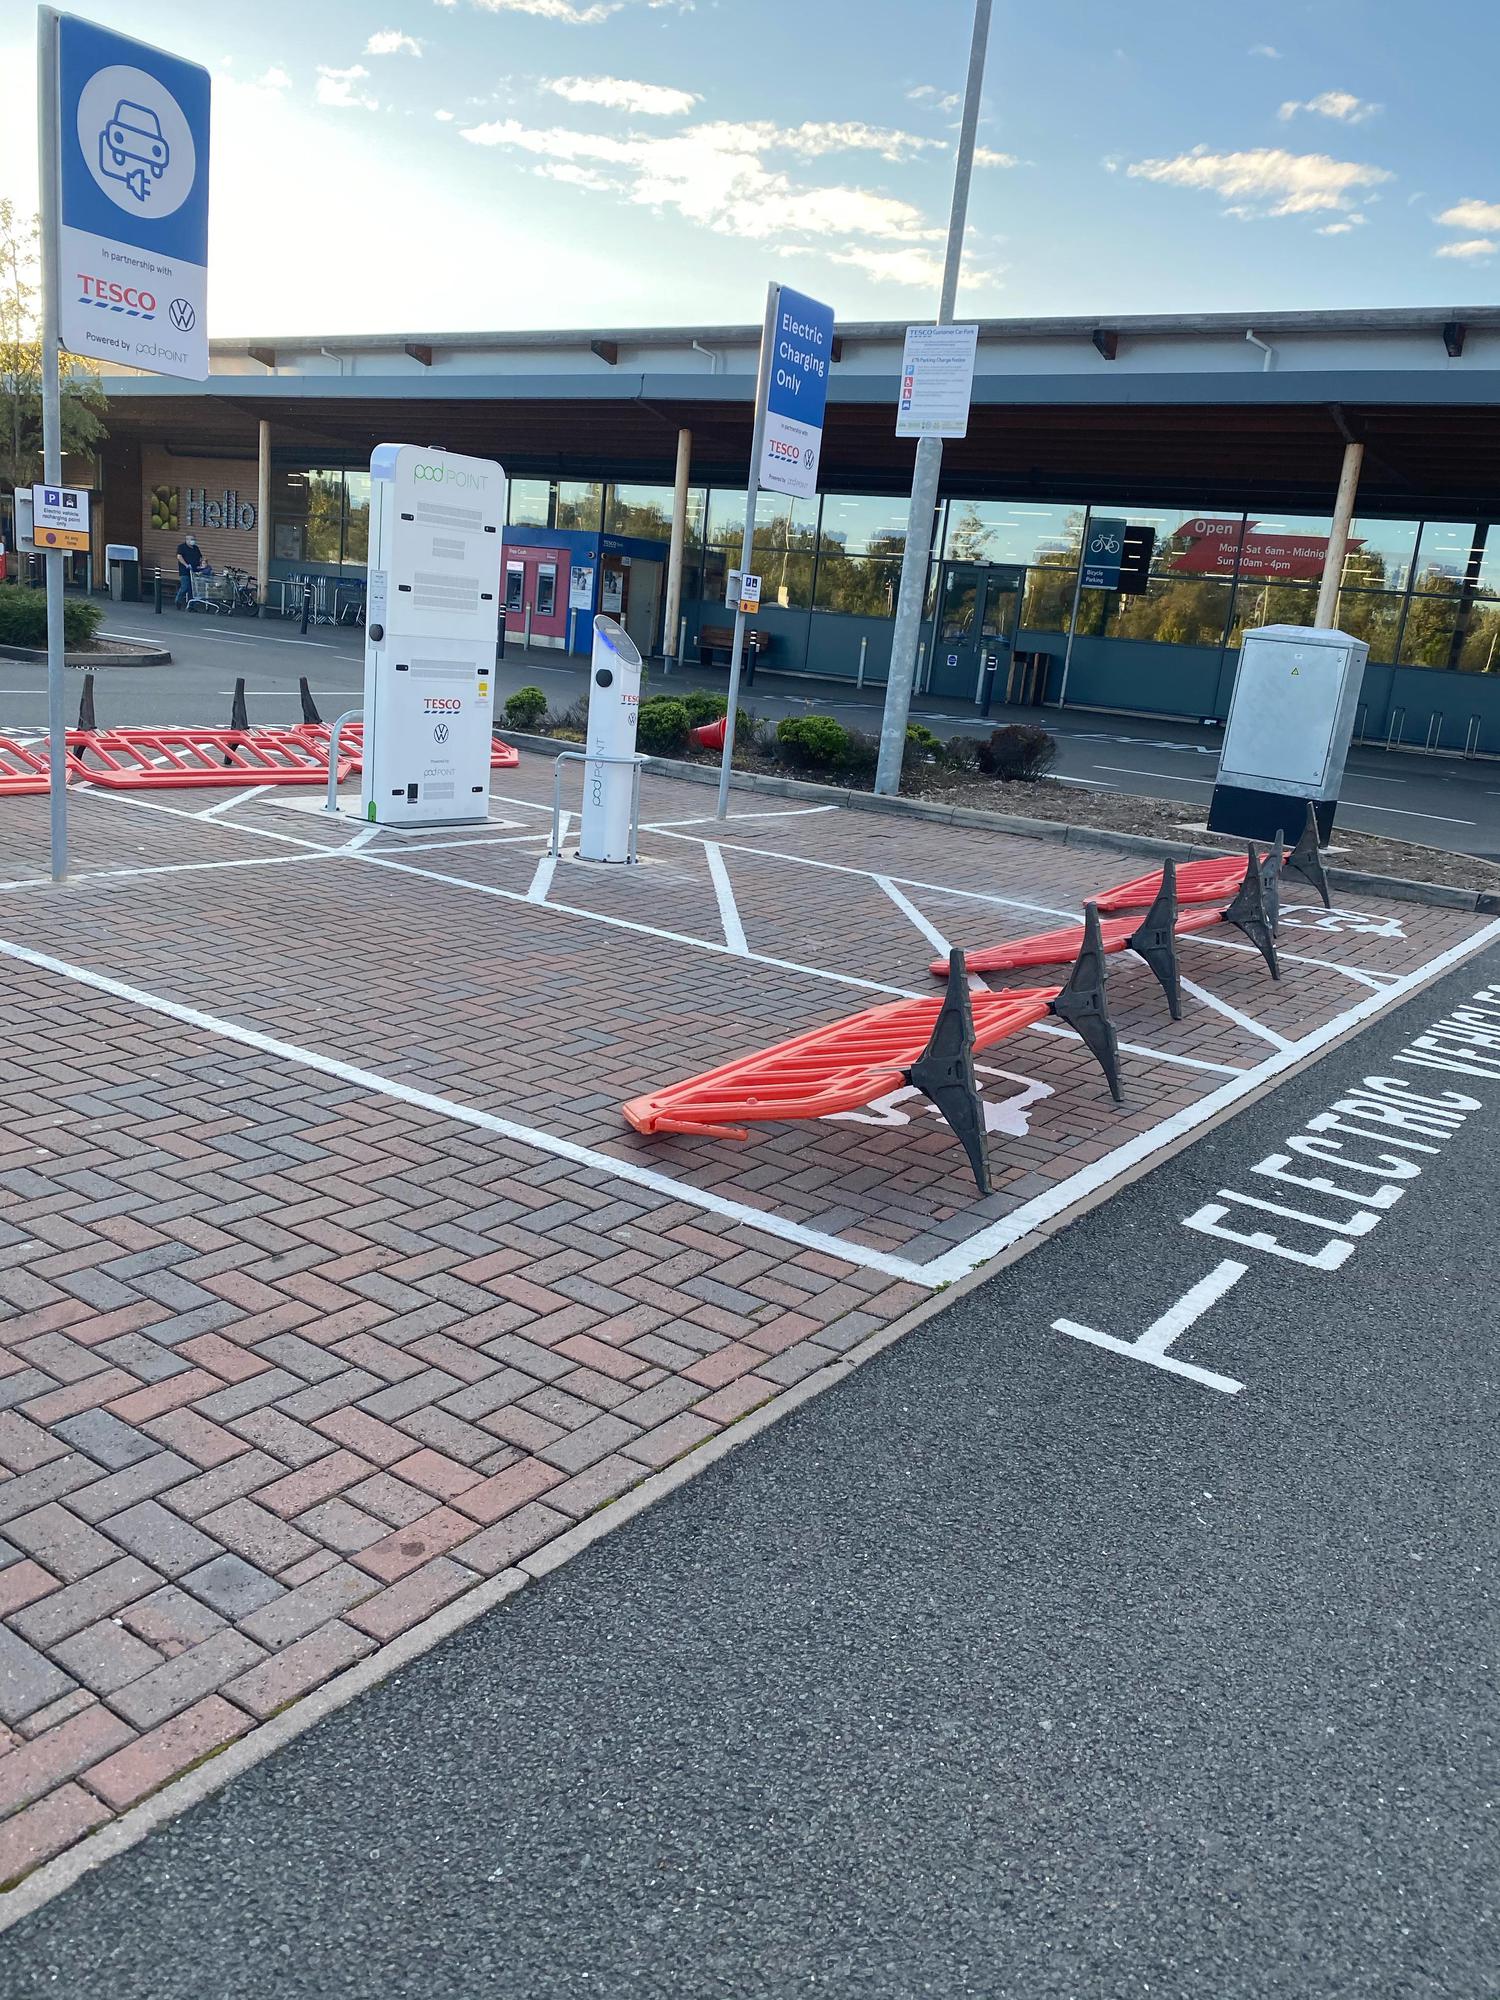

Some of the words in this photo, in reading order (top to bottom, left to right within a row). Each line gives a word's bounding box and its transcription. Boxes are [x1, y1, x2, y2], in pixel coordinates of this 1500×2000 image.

[102, 249, 109, 258] In
[111, 252, 155, 272] partnership
[156, 266, 173, 276] with
[77, 273, 156, 312] TESCO
[86, 331, 120, 348] Powered
[121, 340, 130, 351] by
[782, 313, 823, 345] Electric
[779, 341, 825, 378] Charging
[776, 369, 801, 396] Only
[769, 439, 800, 459] TESCO
[446, 469, 489, 490] POINT
[186, 488, 255, 531] Hello
[1194, 520, 1234, 536] Open
[1217, 556, 1235, 566] Sun
[1239, 558, 1263, 568] 10am
[1270, 562, 1291, 570] 4pm
[1219, 543, 1239, 553] Mon
[1246, 544, 1262, 554] Sat
[1264, 546, 1285, 556] 6am
[1292, 547, 1328, 560] Midnig
[423, 698, 461, 710] TESCO
[620, 694, 640, 702] TESC
[594, 736, 607, 777] PONT
[1181, 1075, 1484, 1272] ELECTRIC
[1392, 984, 1500, 1080] VEHIC
